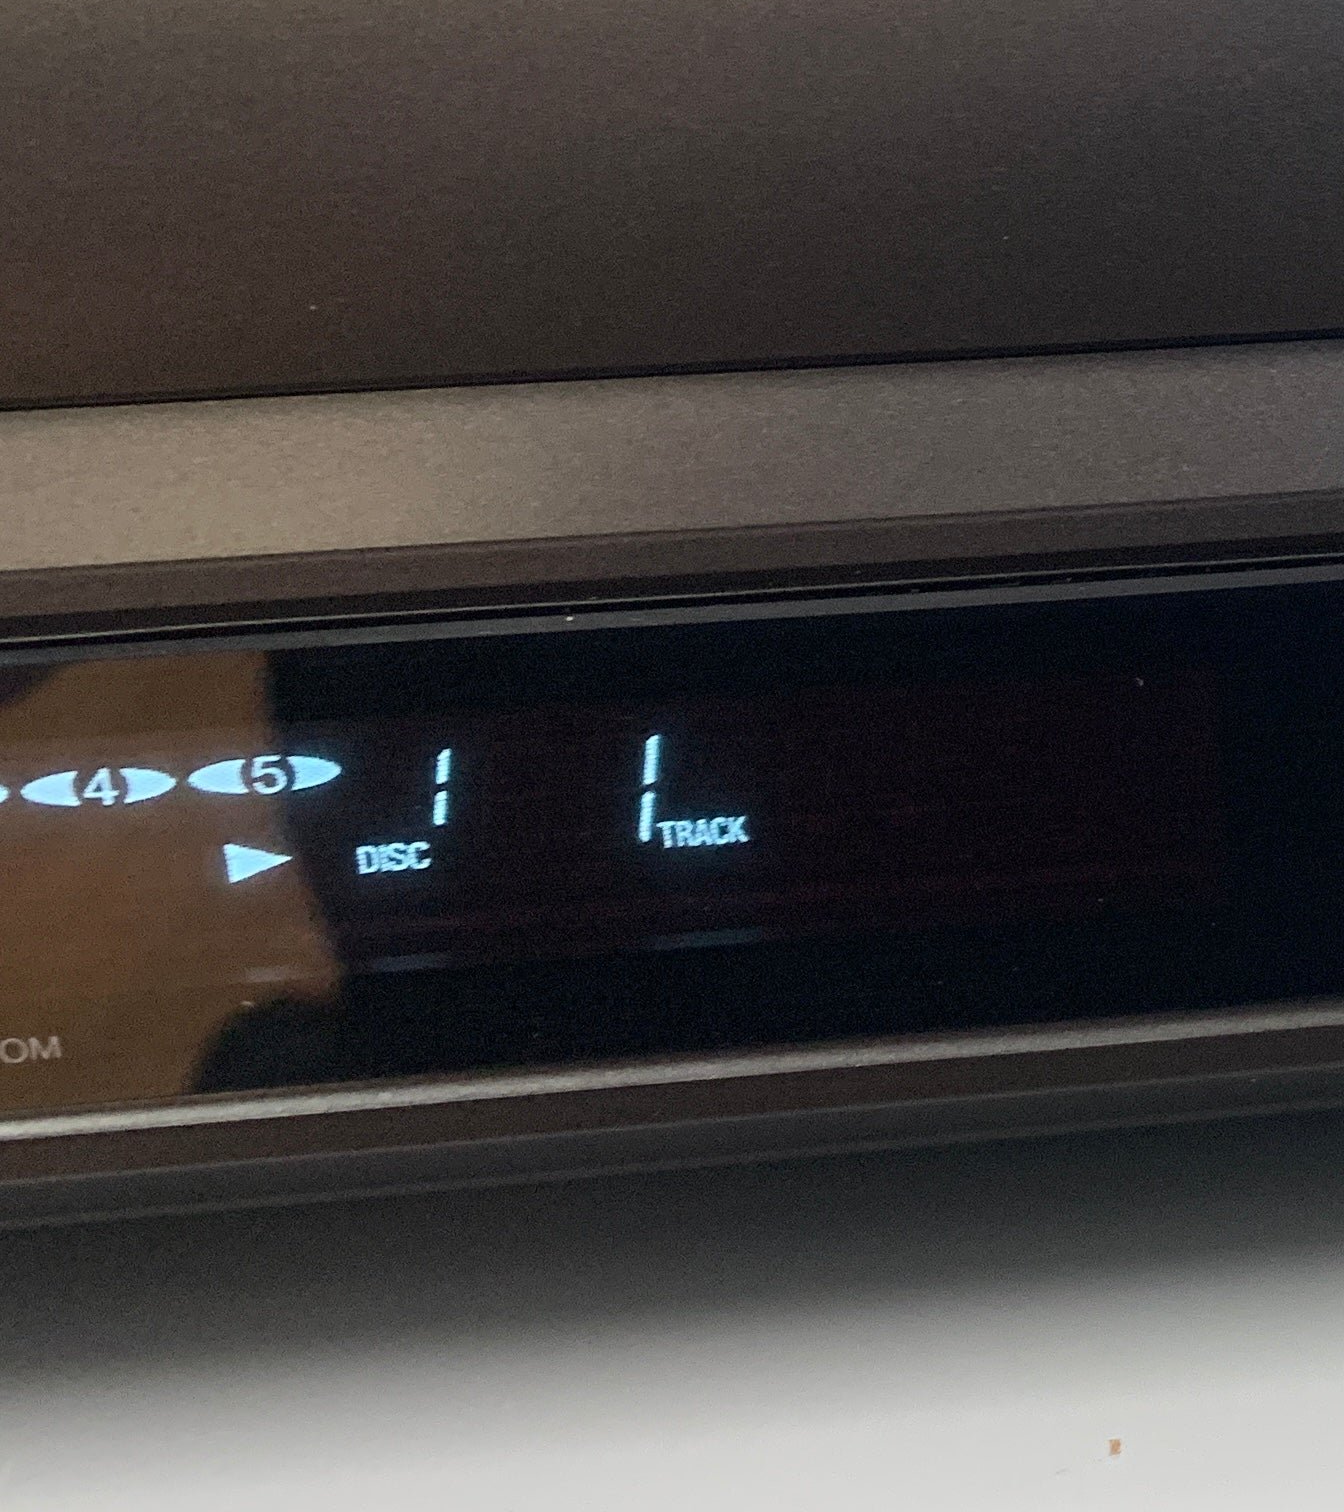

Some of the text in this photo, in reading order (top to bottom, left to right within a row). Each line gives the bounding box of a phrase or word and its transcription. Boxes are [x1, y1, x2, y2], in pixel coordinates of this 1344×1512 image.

[84, 756, 286, 804] 4 5
[658, 816, 748, 847] TRACK
[357, 842, 429, 872] DISC
